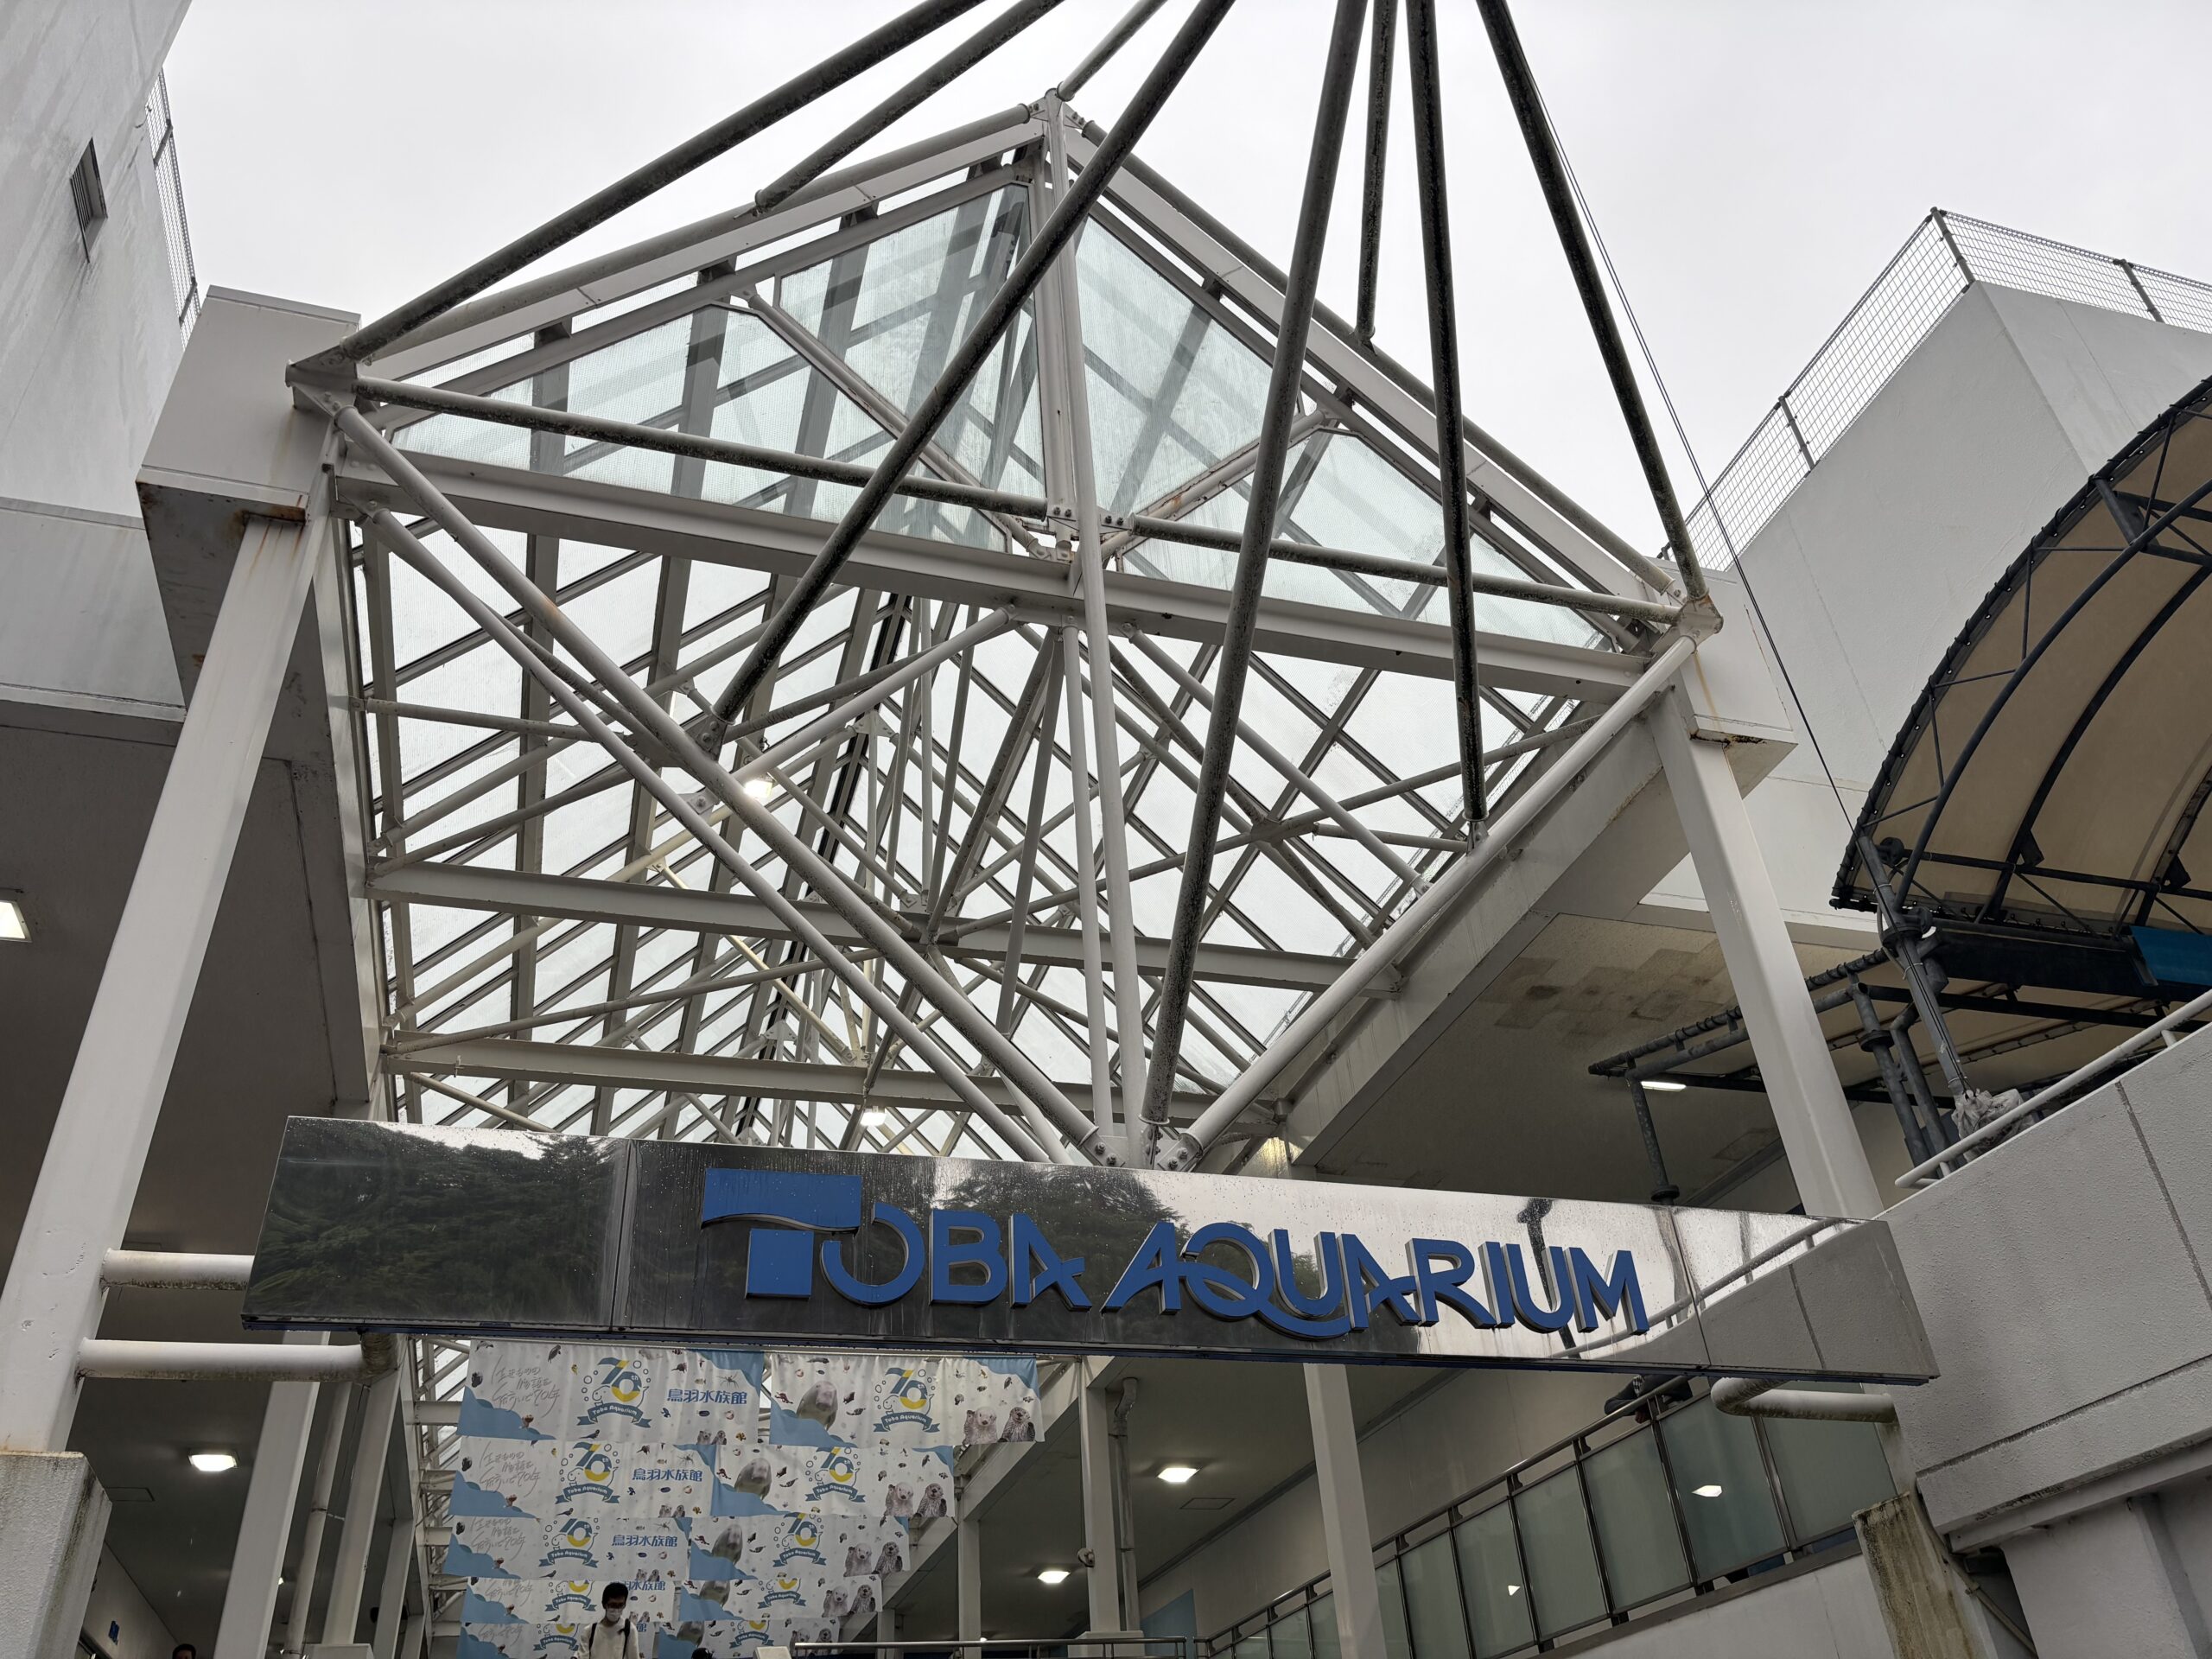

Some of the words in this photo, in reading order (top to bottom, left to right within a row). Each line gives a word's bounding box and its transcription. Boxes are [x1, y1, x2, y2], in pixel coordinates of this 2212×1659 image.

[702, 1168, 1092, 1310] TOBA
[1101, 1222, 1649, 1338] AQUARIUM
[667, 1389, 747, 1405] 鳥羽水族館
[609, 1405, 638, 1415] Aquarium
[632, 1468, 702, 1482] 鳥羽水族館
[612, 1535, 677, 1547] 鳥羽水族館
